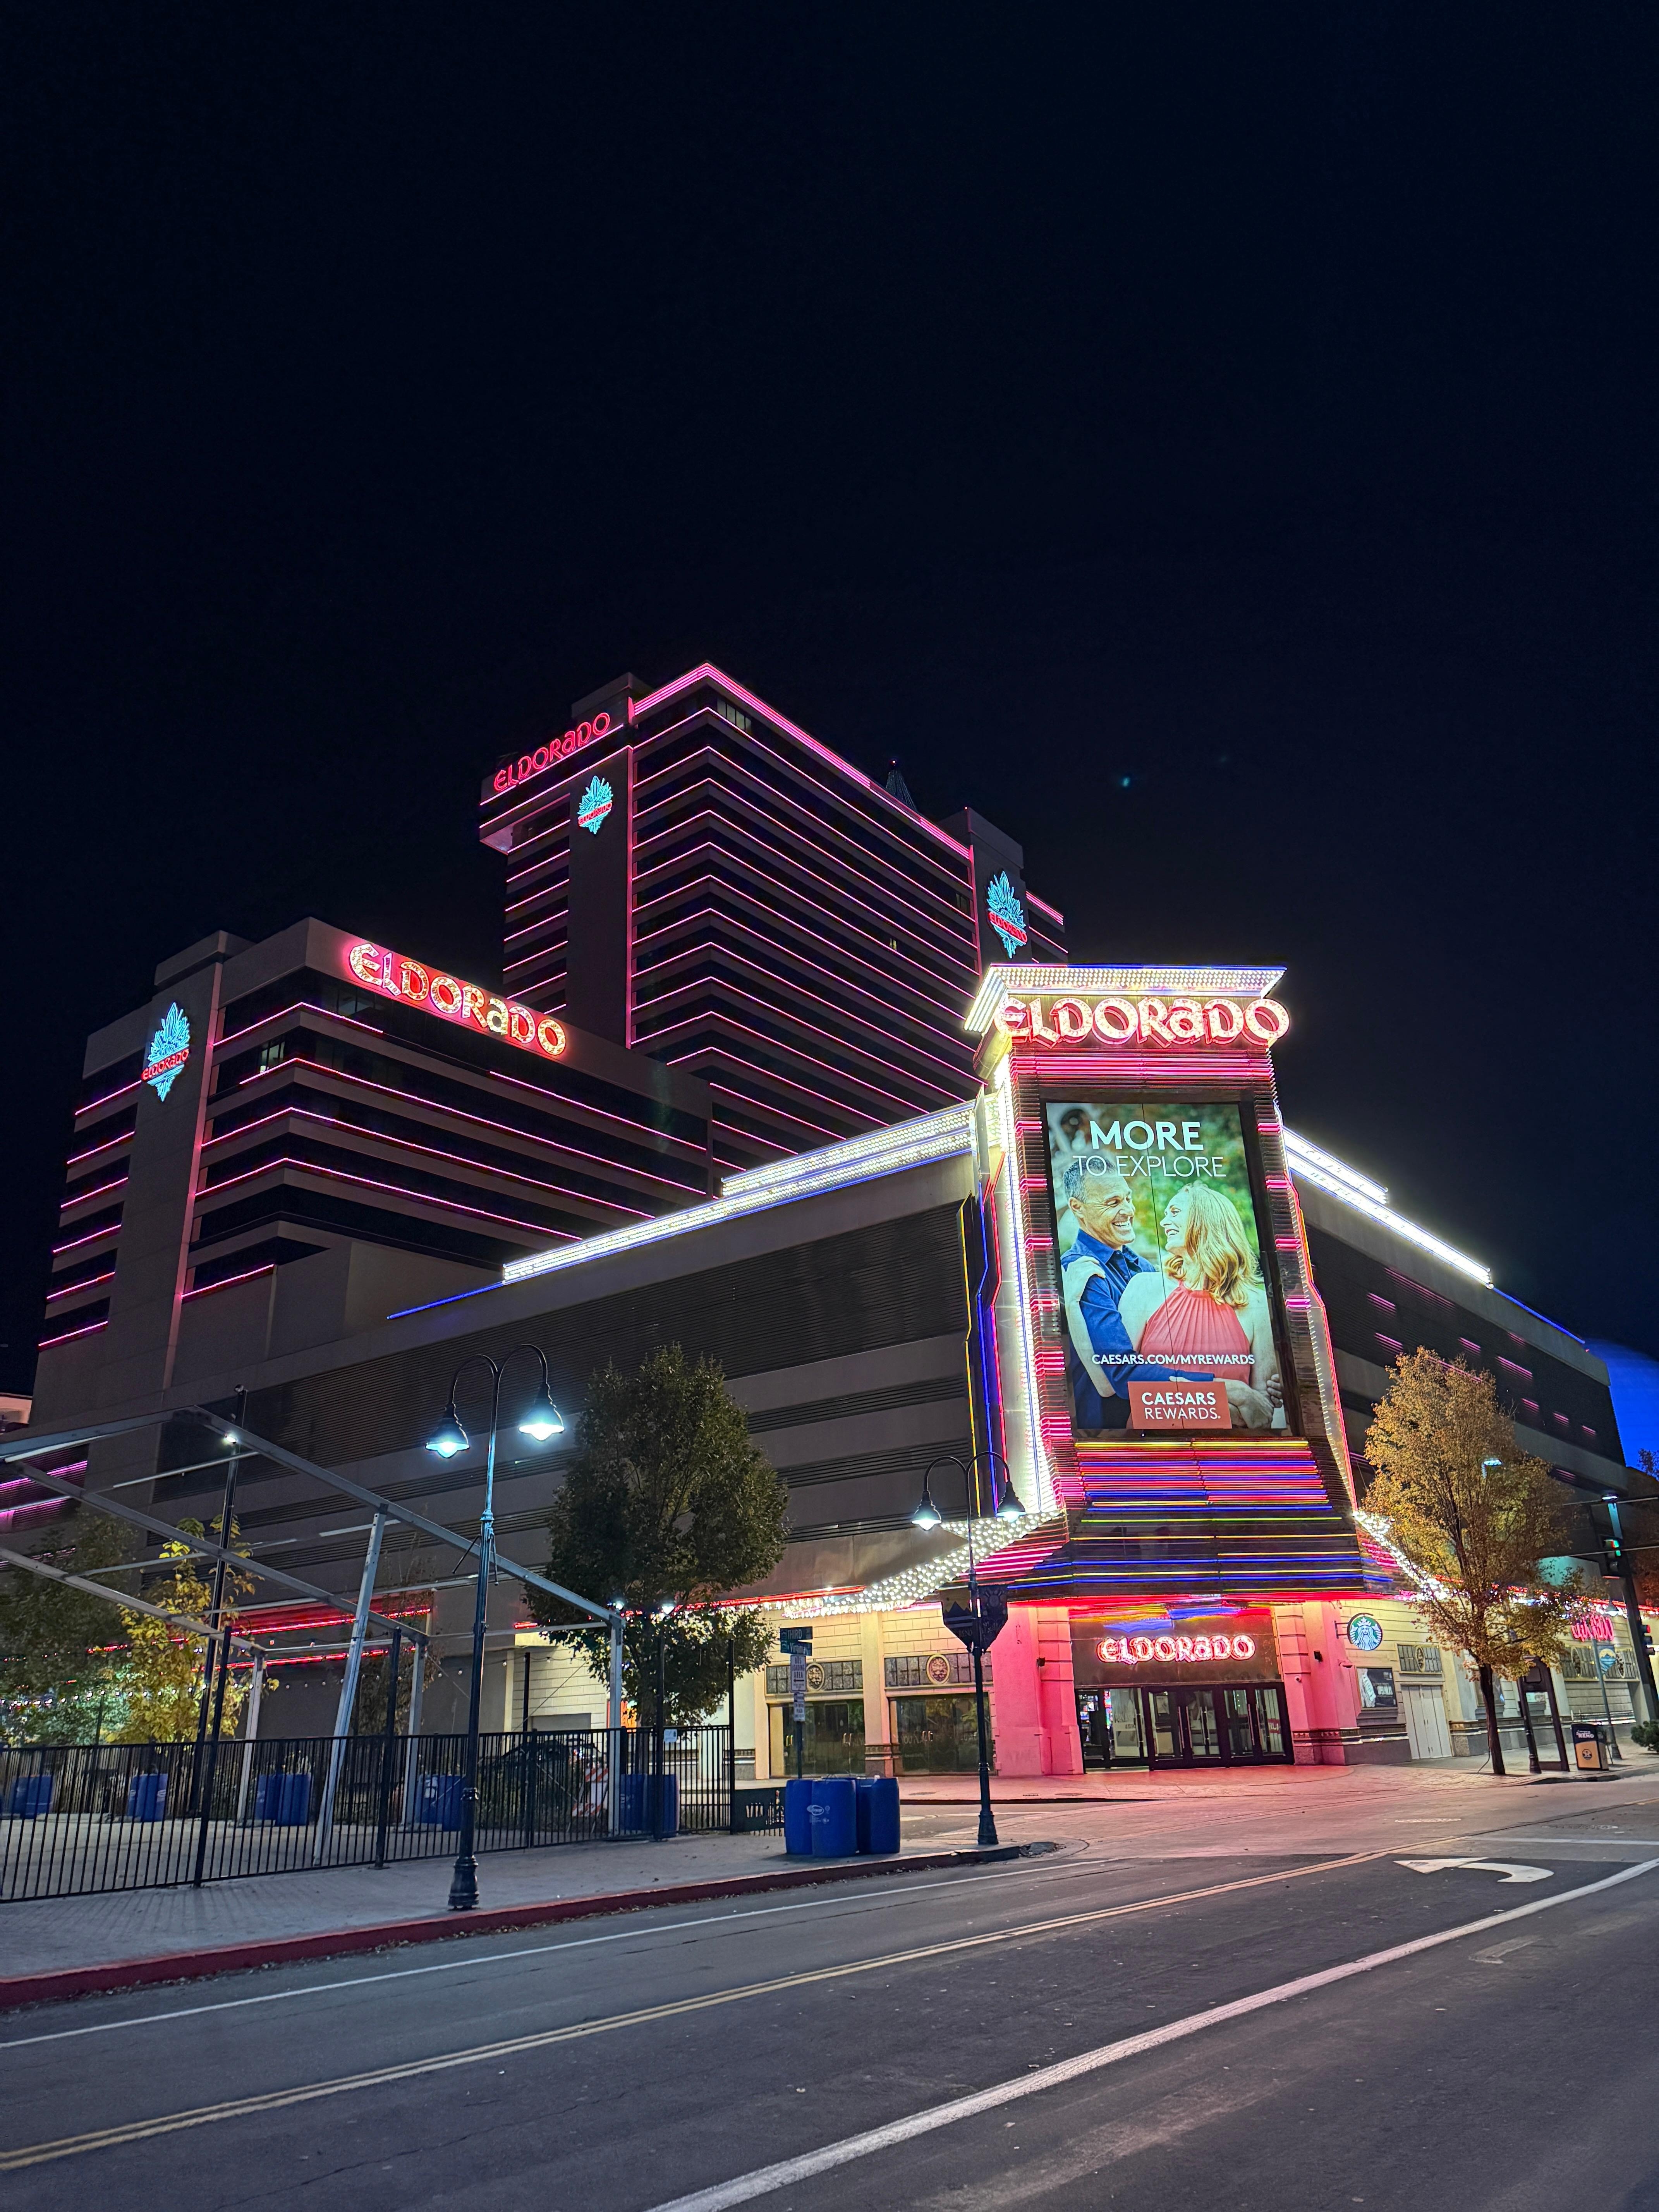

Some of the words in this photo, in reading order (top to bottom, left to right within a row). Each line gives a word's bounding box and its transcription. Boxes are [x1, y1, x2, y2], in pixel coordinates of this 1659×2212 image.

[1089, 1120, 1204, 1150] MORE
[1072, 1155, 1107, 1176] TO
[1116, 1156, 1226, 1177] EXPLORE
[1091, 1354, 1255, 1365] CAESARS.COM/MYREWARDS
[1141, 1392, 1216, 1405] CAESARS
[788, 1629, 802, 1639] THIRD
